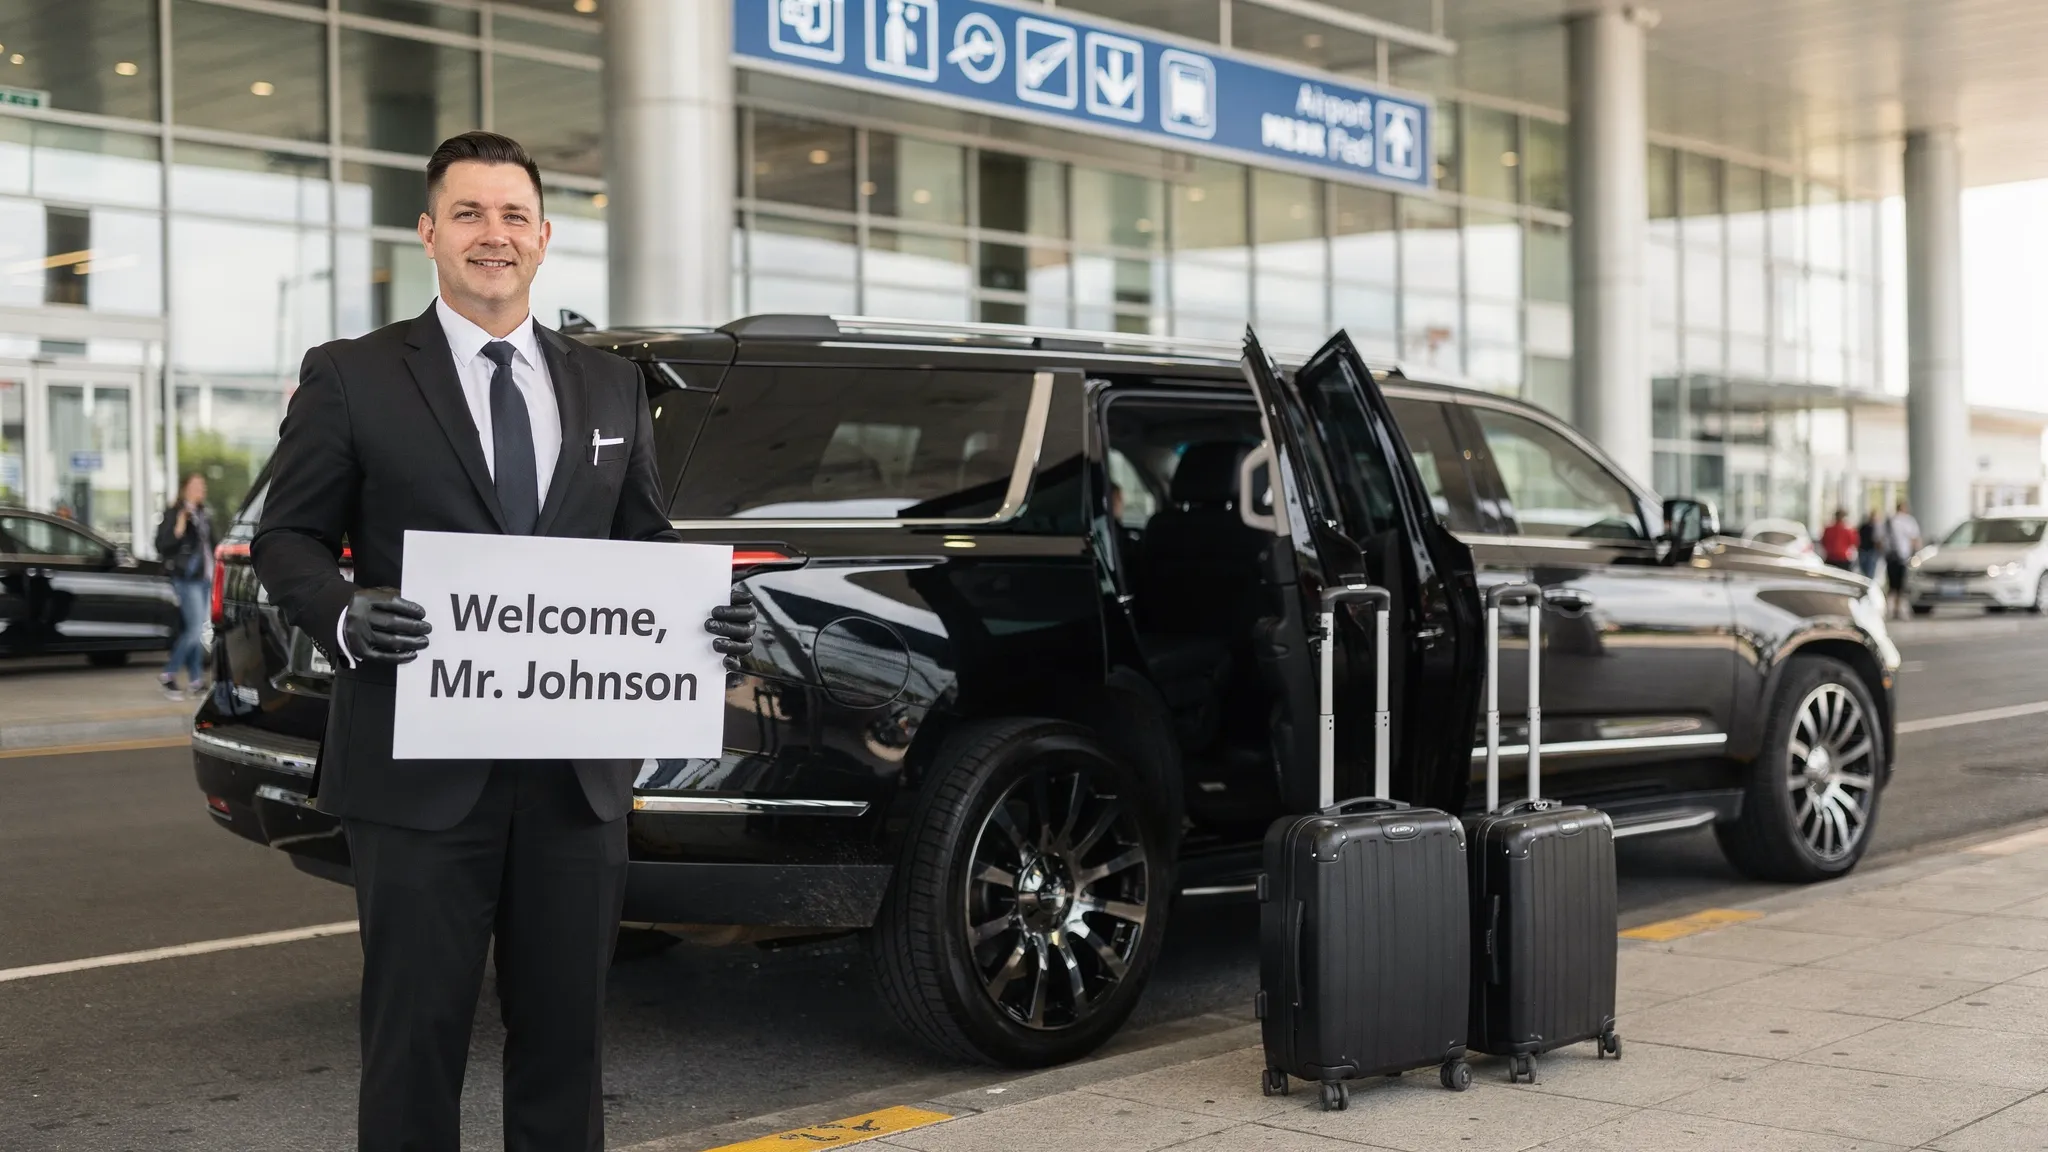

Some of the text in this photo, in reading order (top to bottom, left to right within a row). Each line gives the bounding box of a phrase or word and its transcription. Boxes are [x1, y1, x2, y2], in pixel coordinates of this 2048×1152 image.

[450, 594, 666, 643] Welcome,
[430, 659, 697, 700] Mr. Johnson
